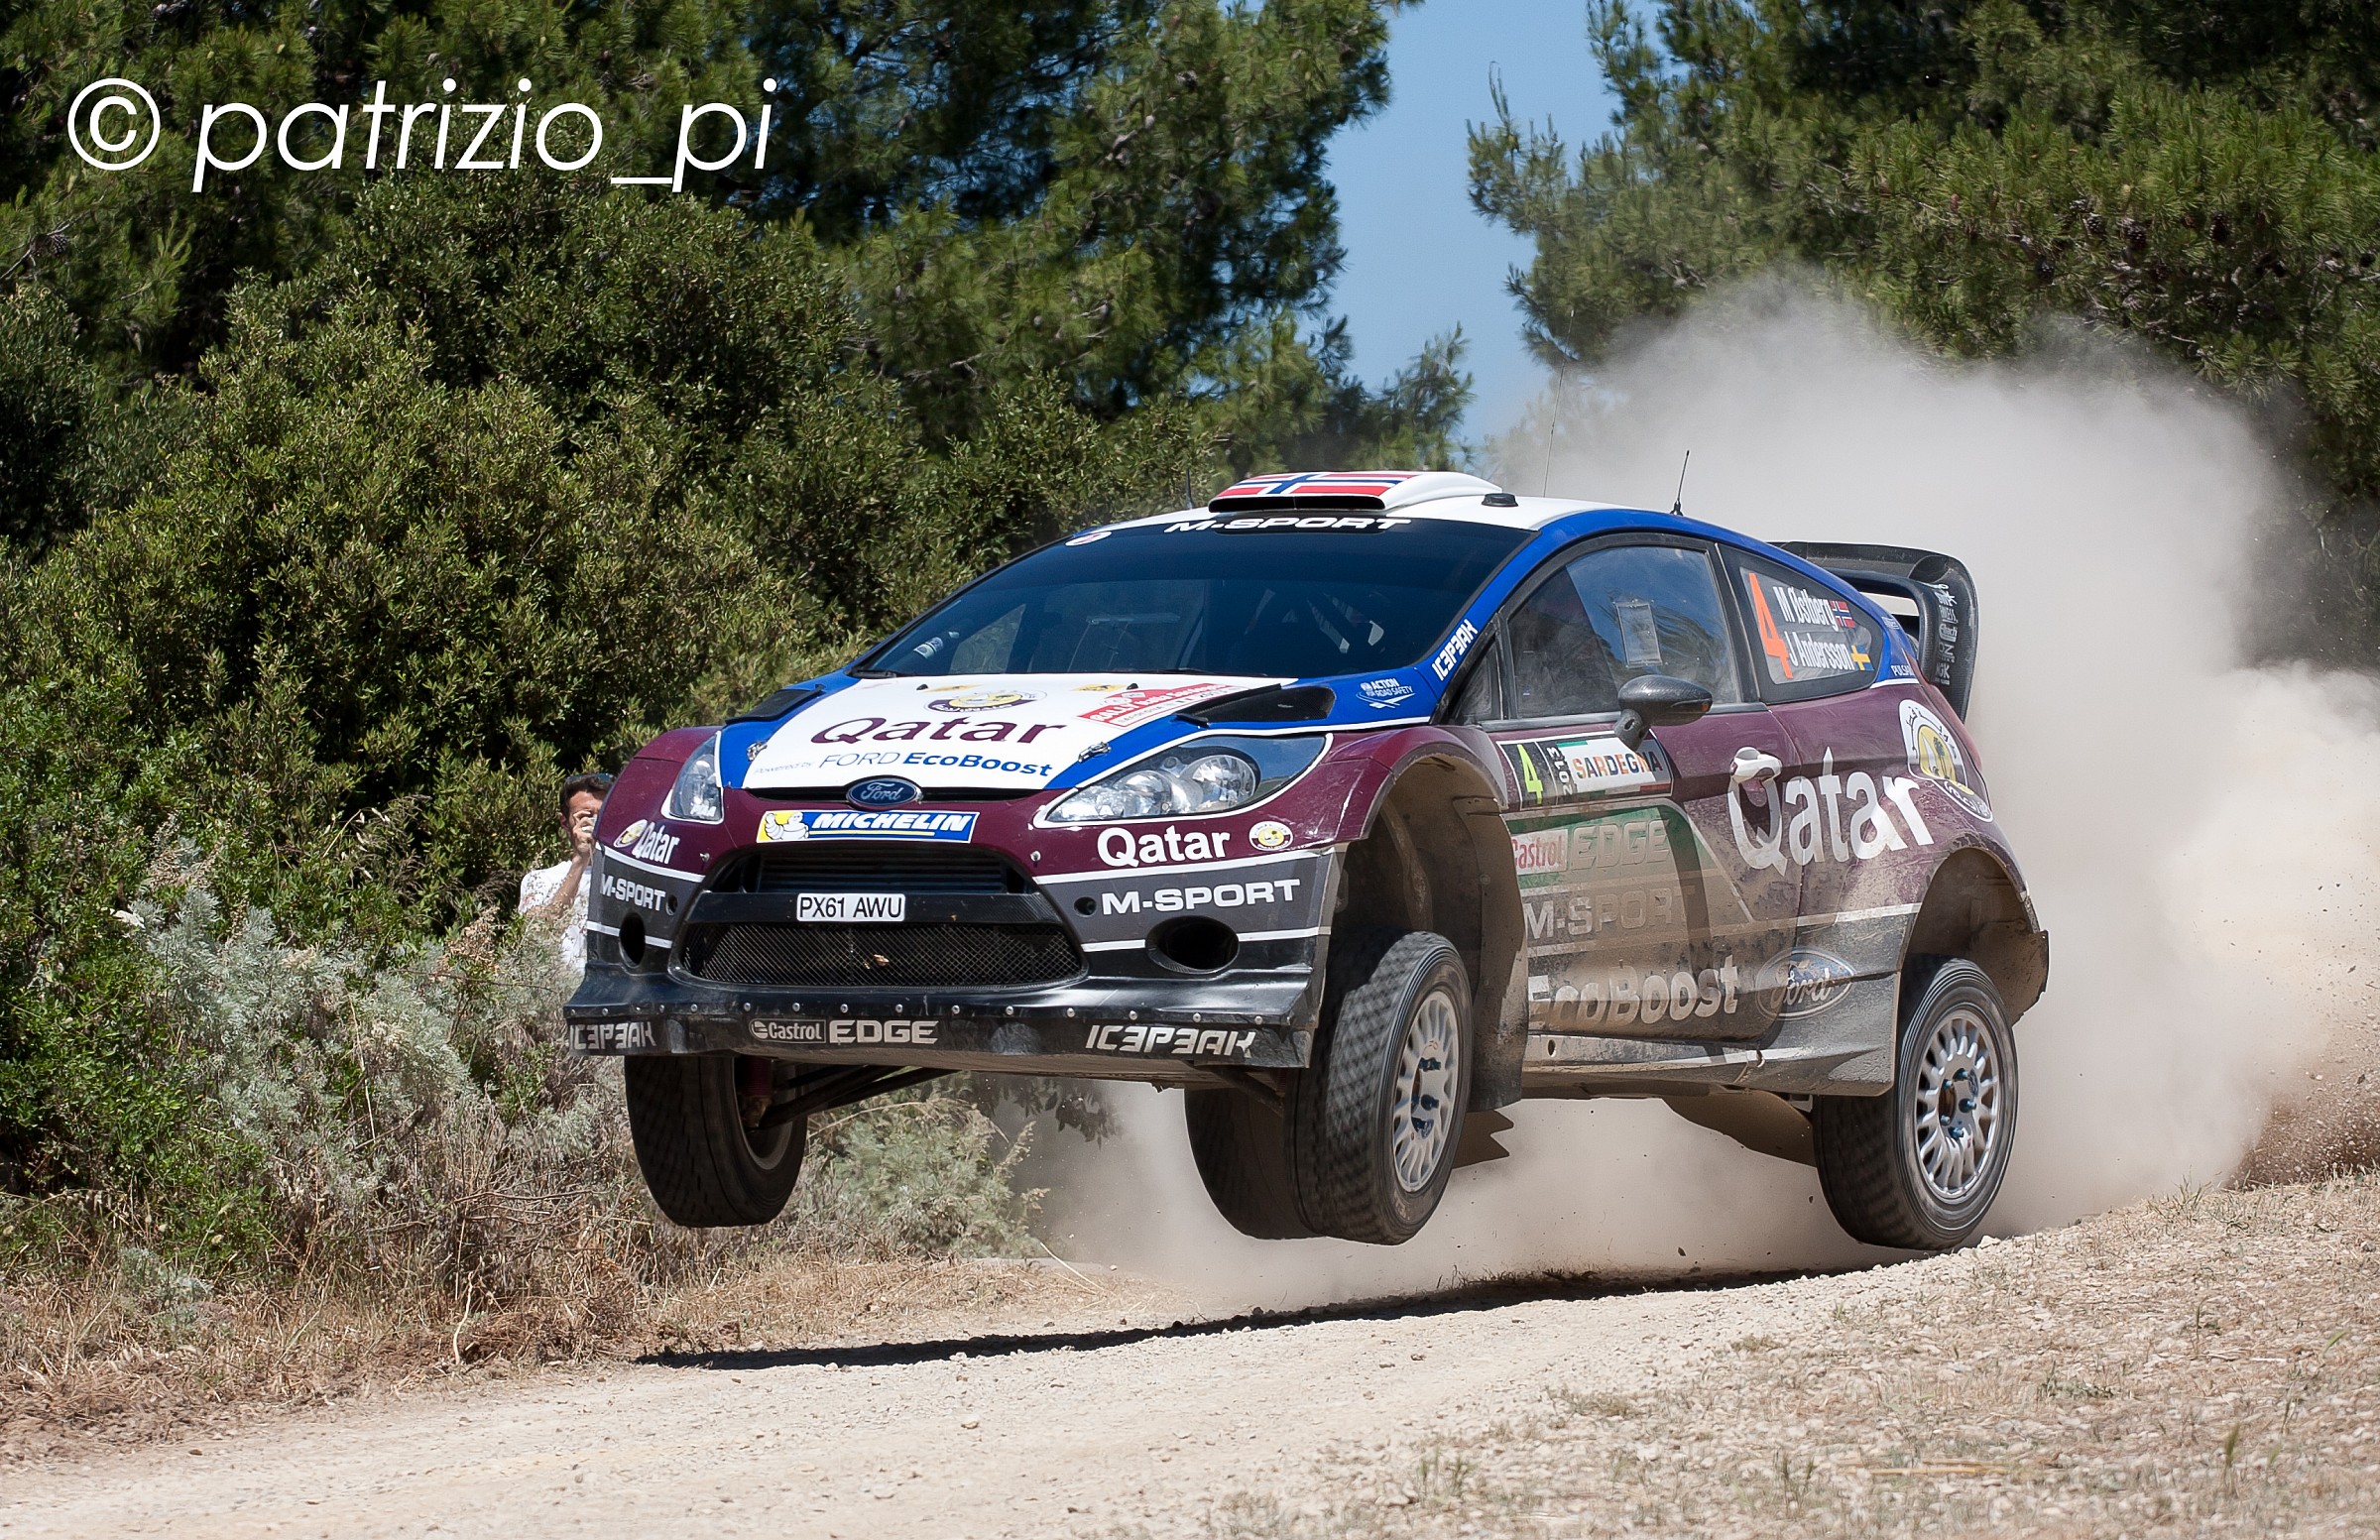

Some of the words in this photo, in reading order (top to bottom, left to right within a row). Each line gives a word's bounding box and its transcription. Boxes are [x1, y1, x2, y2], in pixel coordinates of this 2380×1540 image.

[1164, 517, 1412, 533] M-SPORT
[1772, 586, 1796, 623] M
[1748, 572, 1794, 679] 4
[1792, 631, 1855, 670] Andersson
[810, 715, 1068, 745] Qatar
[819, 752, 900, 769] FORD
[902, 752, 1053, 777] EcoBoost
[1516, 744, 1544, 804] 4
[1547, 746, 1577, 795] 2013
[1572, 751, 1664, 779] SARDEGNA
[860, 779, 901, 802] Ford
[810, 812, 972, 832] MICHELIN
[1727, 746, 1934, 877] Qatar
[631, 822, 681, 865] Qatar
[1097, 825, 1231, 868] Qatar
[1571, 819, 1671, 871] EDGE
[600, 873, 666, 911] M-SPORT
[799, 896, 845, 918] PX61
[852, 896, 902, 918] AWU
[1101, 879, 1301, 915] M-SPORT
[769, 1021, 822, 1040] Castrol
[828, 1019, 939, 1045] EDGE
